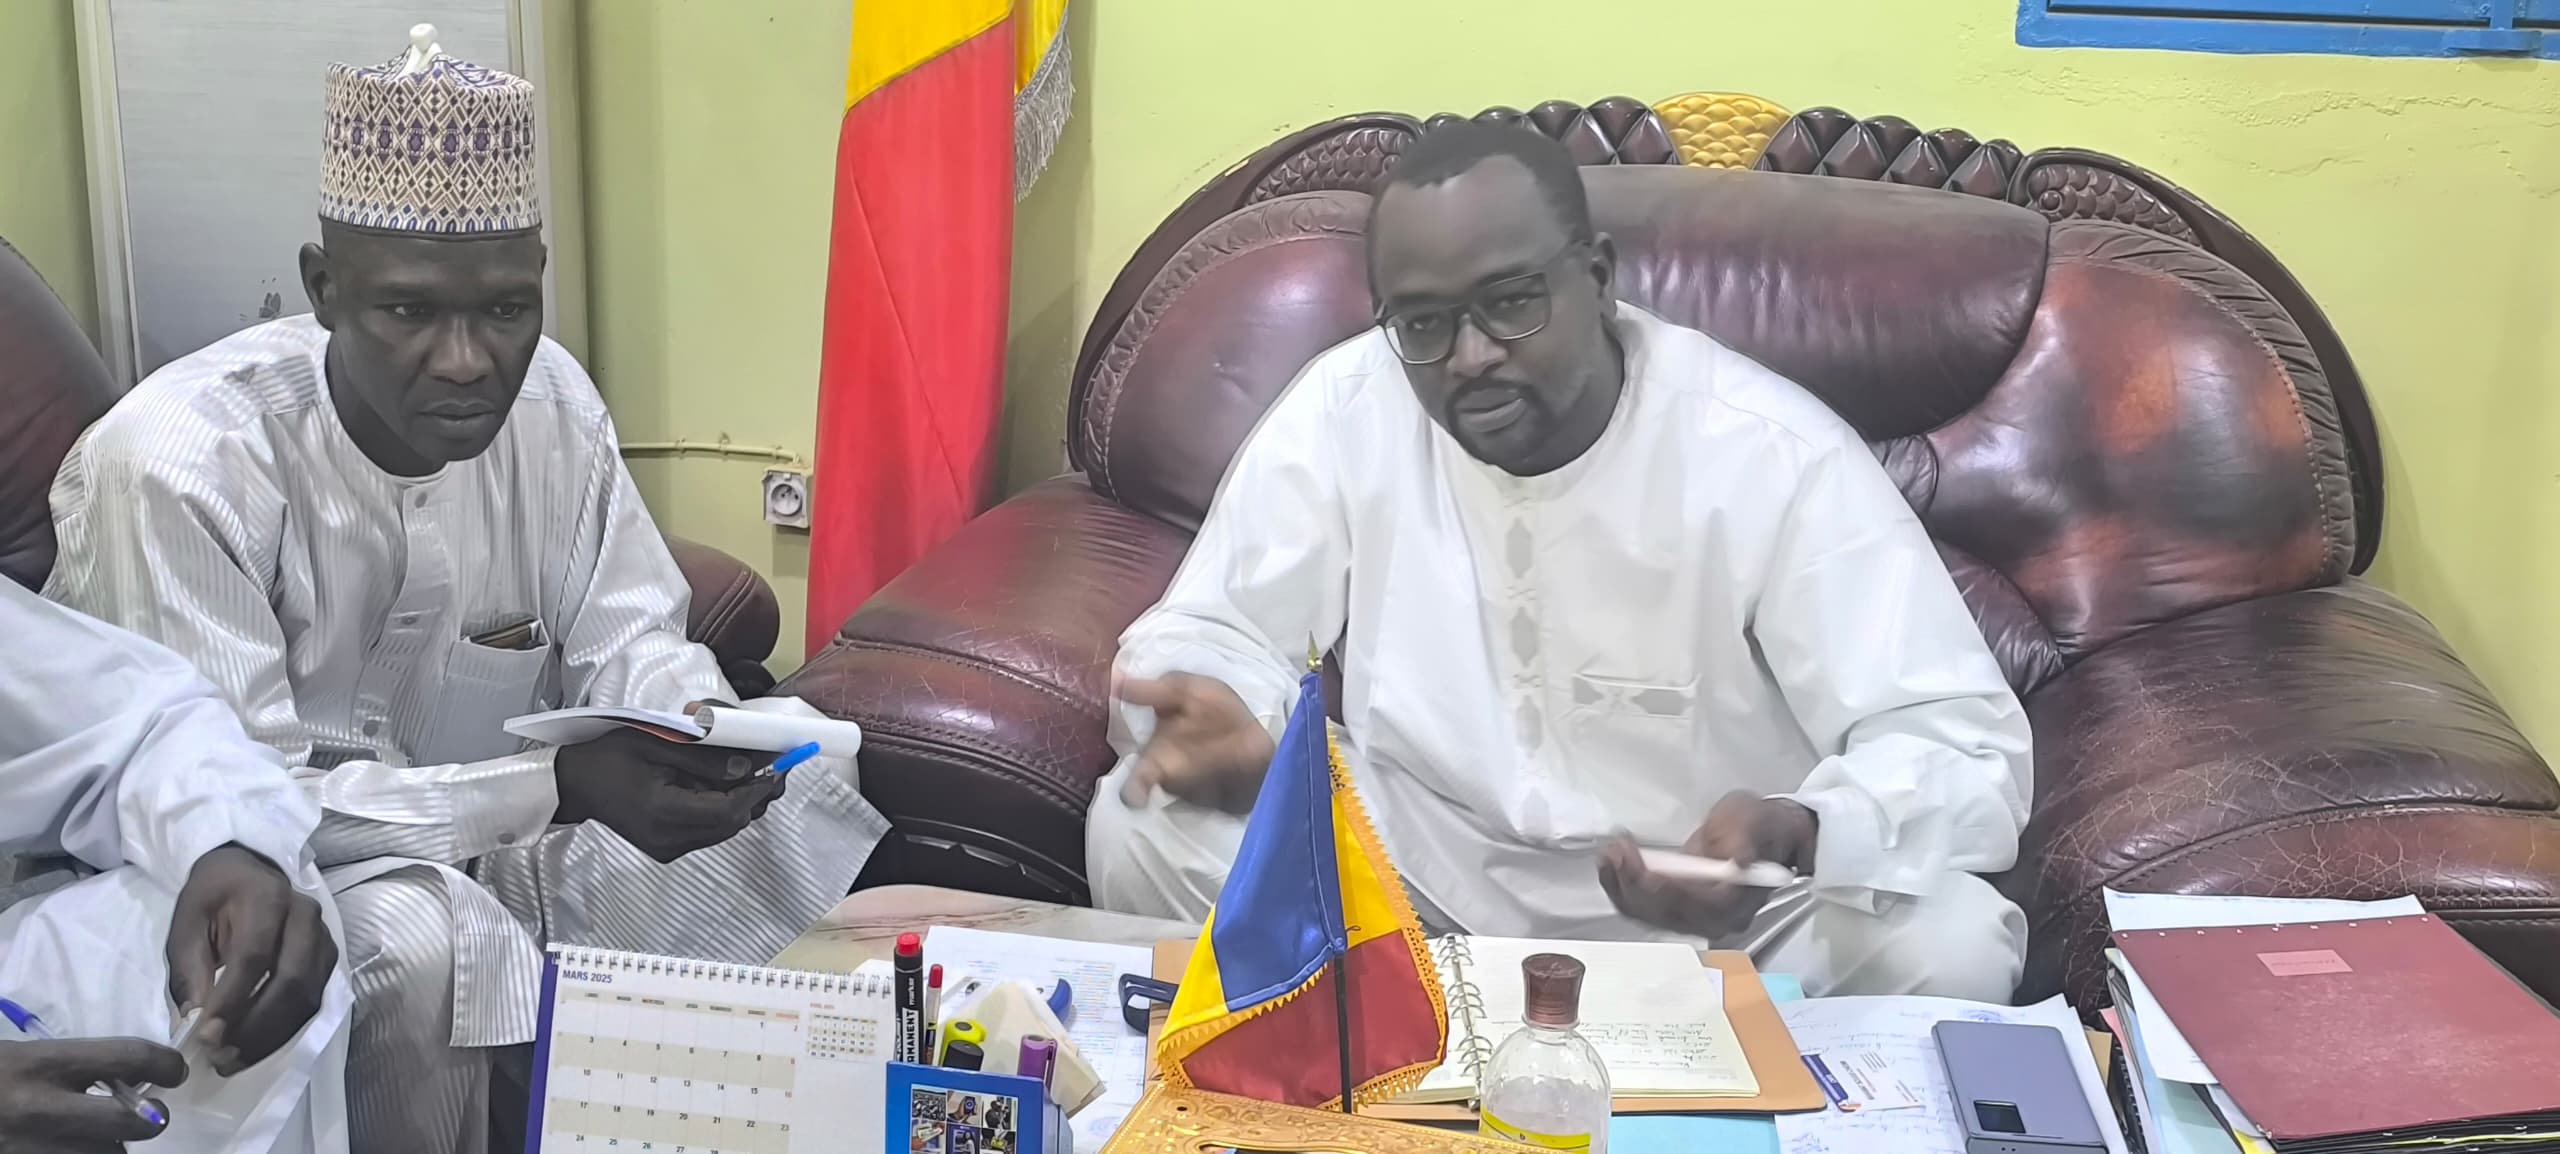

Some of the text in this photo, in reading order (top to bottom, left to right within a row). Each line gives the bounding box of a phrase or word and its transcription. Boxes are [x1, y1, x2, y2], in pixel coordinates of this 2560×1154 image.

[562, 969, 612, 984] MARS 2025
[906, 1010, 915, 1063] RMANENT
[616, 1071, 624, 1080] 11
[683, 1079, 692, 1088] 13
[679, 1112, 688, 1120] 20
[780, 1123, 790, 1132] 23
